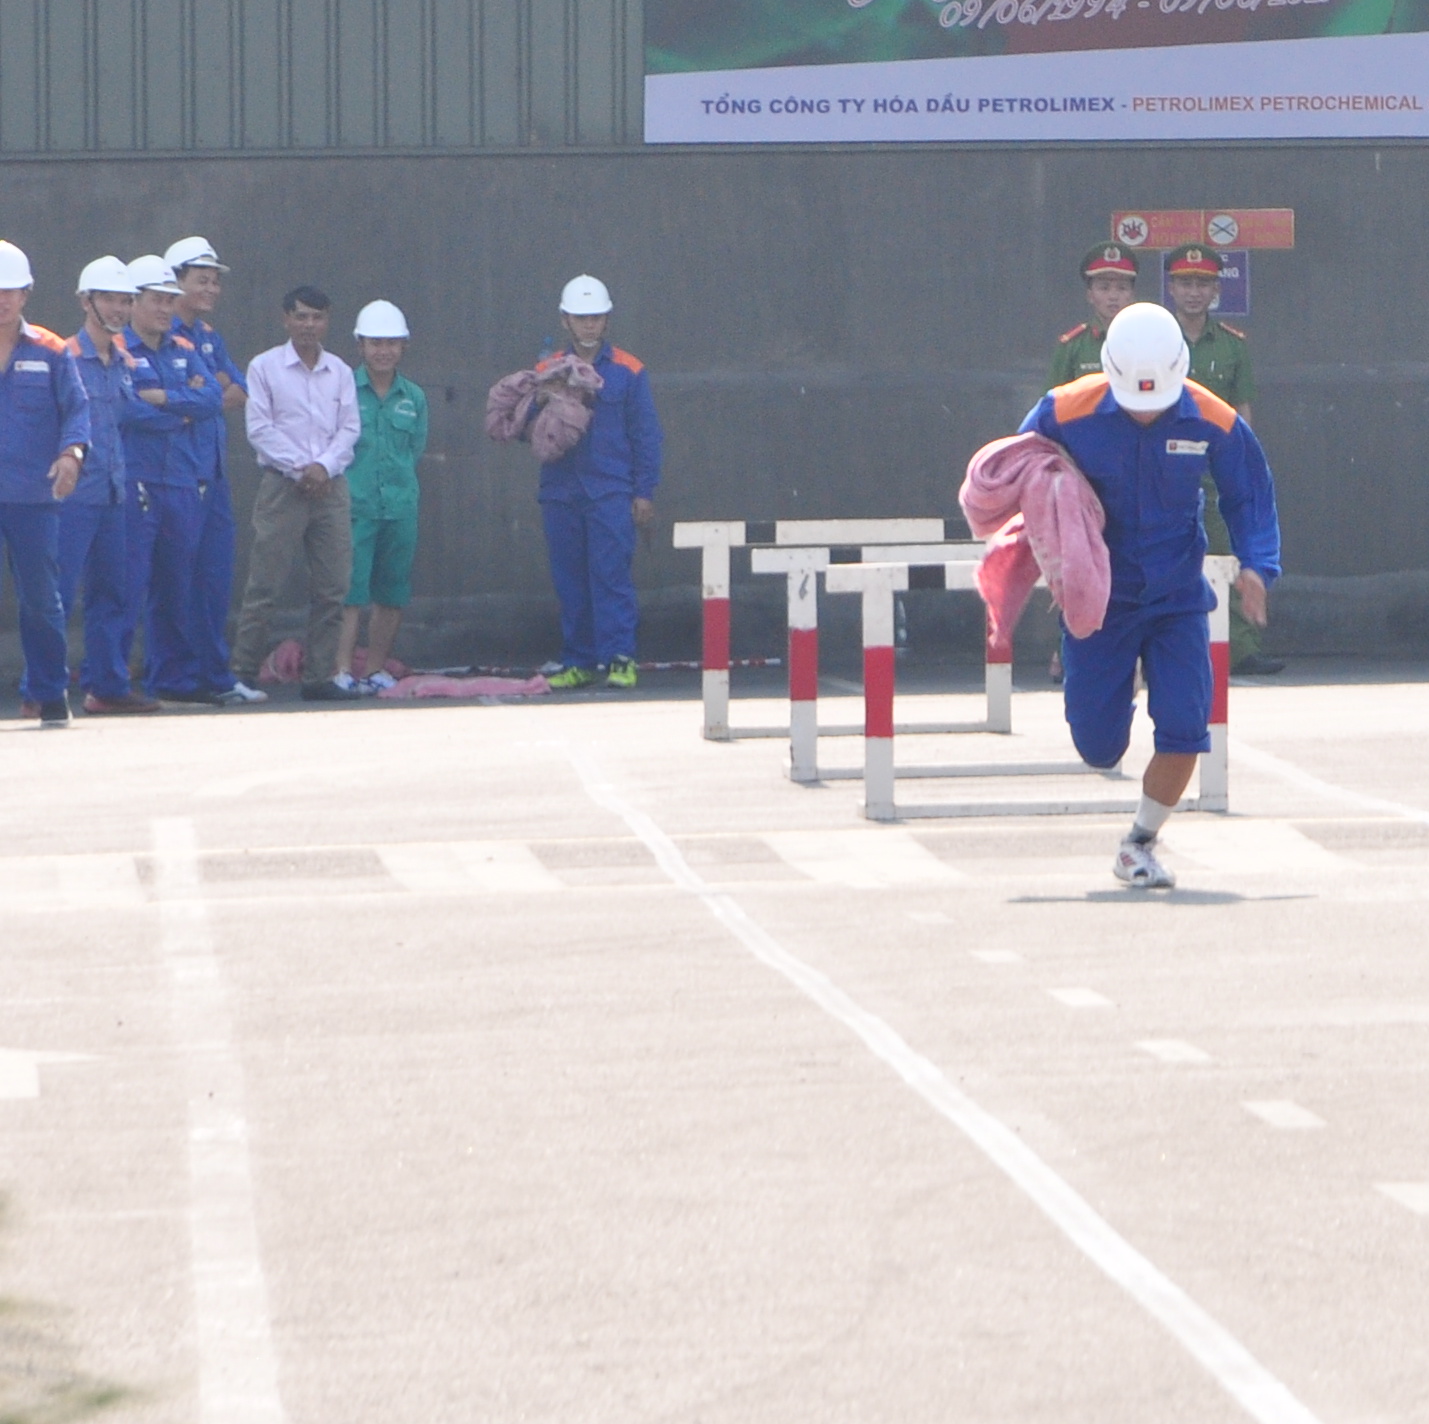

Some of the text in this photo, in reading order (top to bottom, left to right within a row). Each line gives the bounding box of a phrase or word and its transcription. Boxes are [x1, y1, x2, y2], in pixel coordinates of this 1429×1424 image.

[701, 92, 762, 115] TỔNG
[769, 95, 831, 115] CÔNG
[838, 98, 866, 114] TY
[873, 94, 919, 114] HÓA
[978, 96, 1116, 114] PETROLIMEX
[1132, 96, 1255, 113] PETROLIMEX
[1260, 95, 1423, 113] PETROCHEMICAL
